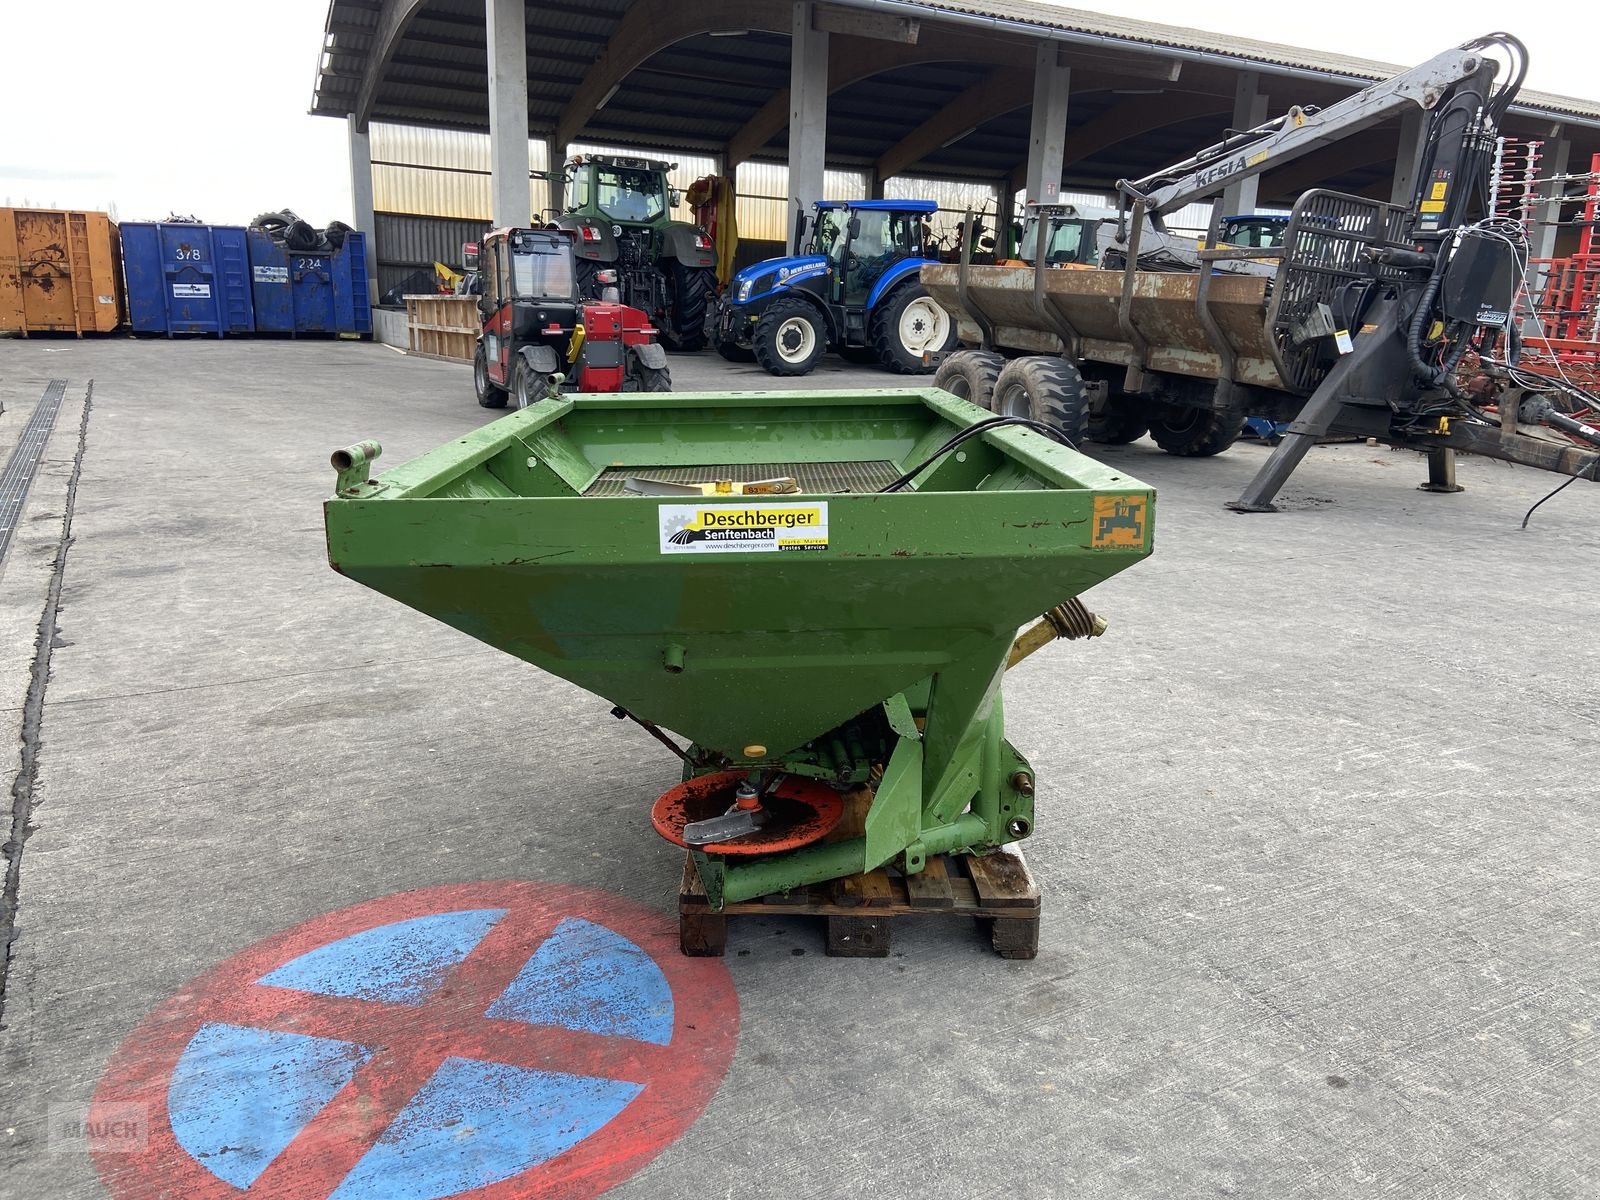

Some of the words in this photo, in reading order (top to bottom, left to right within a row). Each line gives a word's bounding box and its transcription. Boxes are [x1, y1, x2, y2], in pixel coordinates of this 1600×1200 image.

[176, 249, 200, 260] 378
[299, 258, 321, 269] 224
[790, 266, 803, 275] NEW
[803, 261, 826, 271] HOLLAND
[704, 511, 813, 528] Deschberger
[705, 528, 774, 541] Senftenbach
[705, 542, 774, 551] www.deschberger.com
